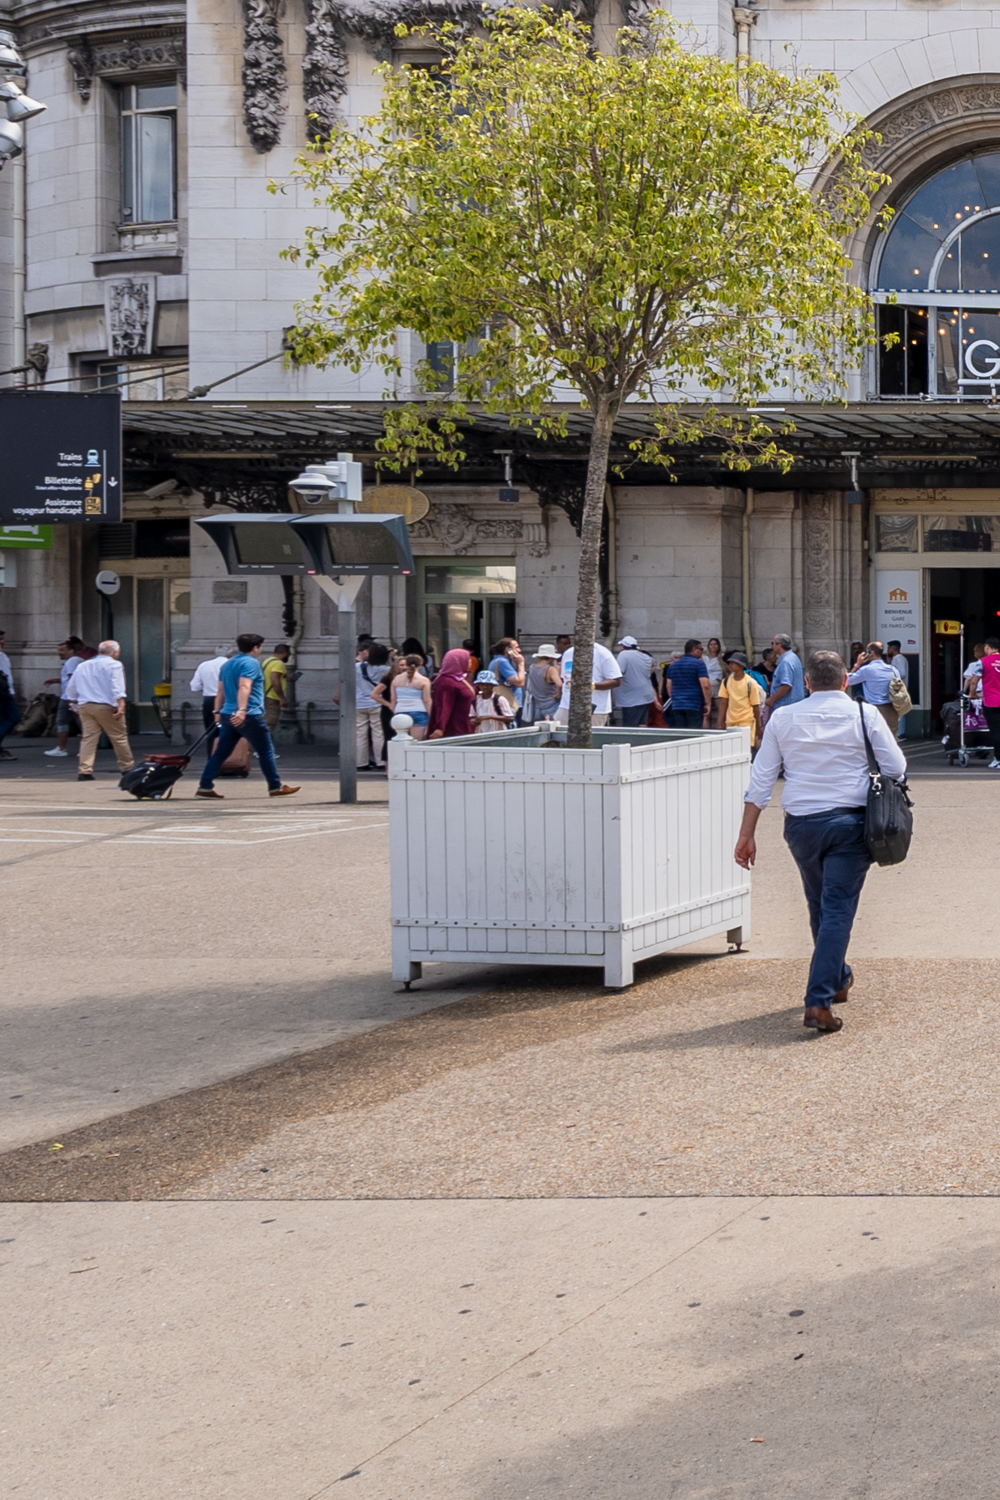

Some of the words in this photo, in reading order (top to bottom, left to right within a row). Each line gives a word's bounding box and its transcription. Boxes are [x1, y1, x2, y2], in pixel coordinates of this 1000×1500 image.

[59, 453, 82, 461] Trains
[44, 476, 82, 485] Billetterie
[45, 498, 82, 506] Assistance
[12, 508, 45, 516] voyageur
[46, 507, 82, 515] handicapé
